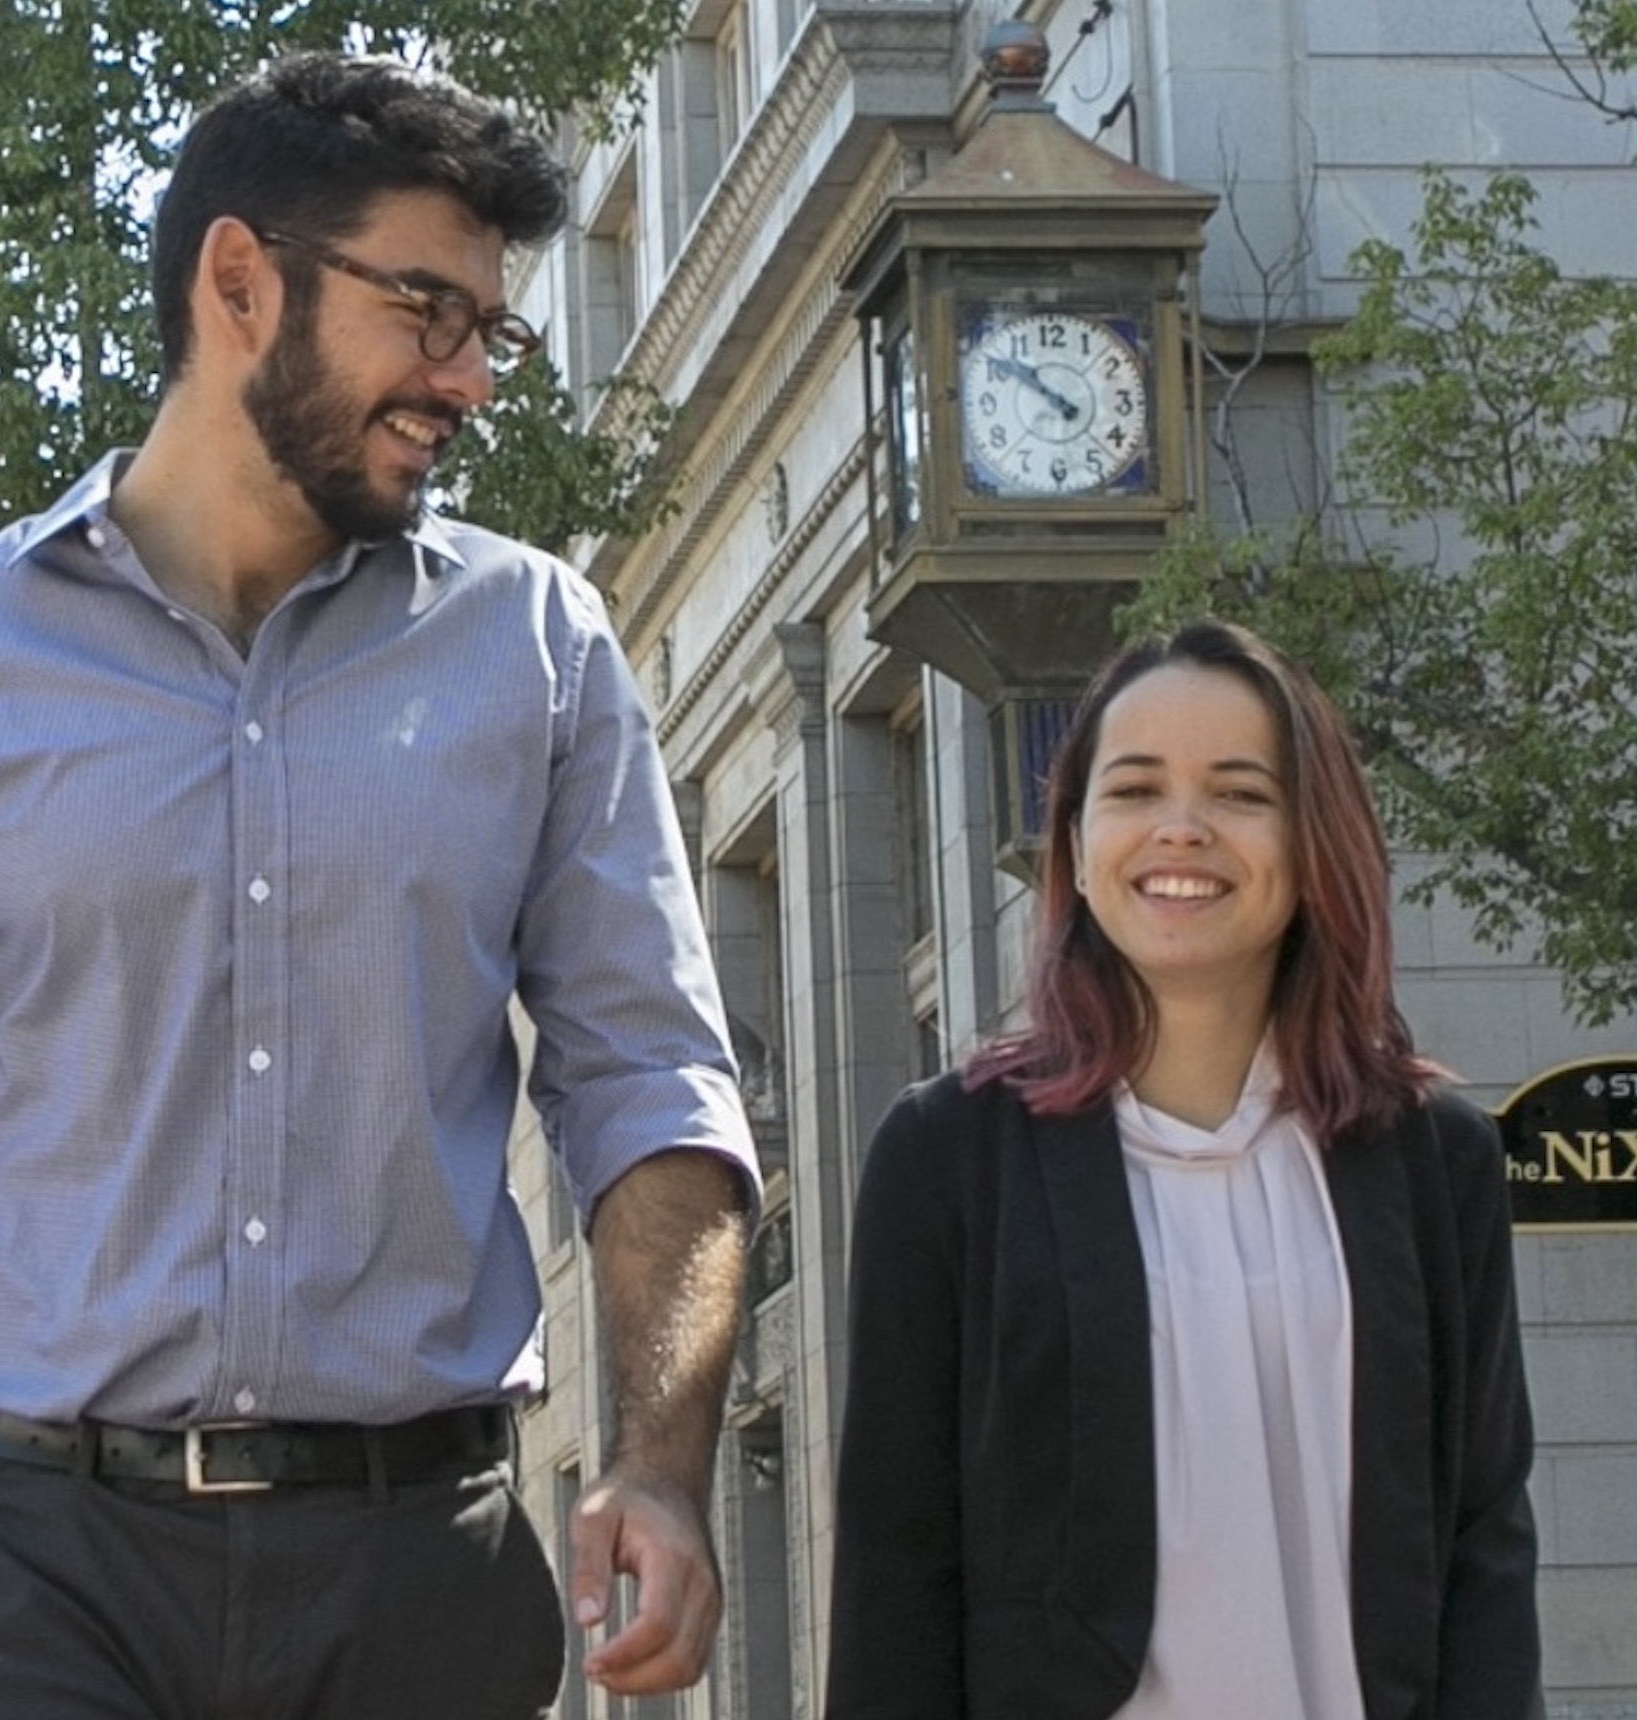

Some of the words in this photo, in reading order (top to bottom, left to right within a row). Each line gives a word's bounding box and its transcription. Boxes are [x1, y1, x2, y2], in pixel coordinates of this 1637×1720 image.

[1010, 334, 1028, 357] 11
[1039, 325, 1066, 348] 12
[1080, 334, 1091, 355] 1
[1104, 357, 1120, 380] 2
[978, 393, 997, 415] 9
[1115, 390, 1133, 416] 3
[989, 425, 1007, 449] 8
[1107, 423, 1125, 448] 4
[1018, 449, 1032, 474] 7
[1050, 457, 1067, 482] 6
[1087, 449, 1103, 474] 5
[1505, 1152, 1541, 1182] he
